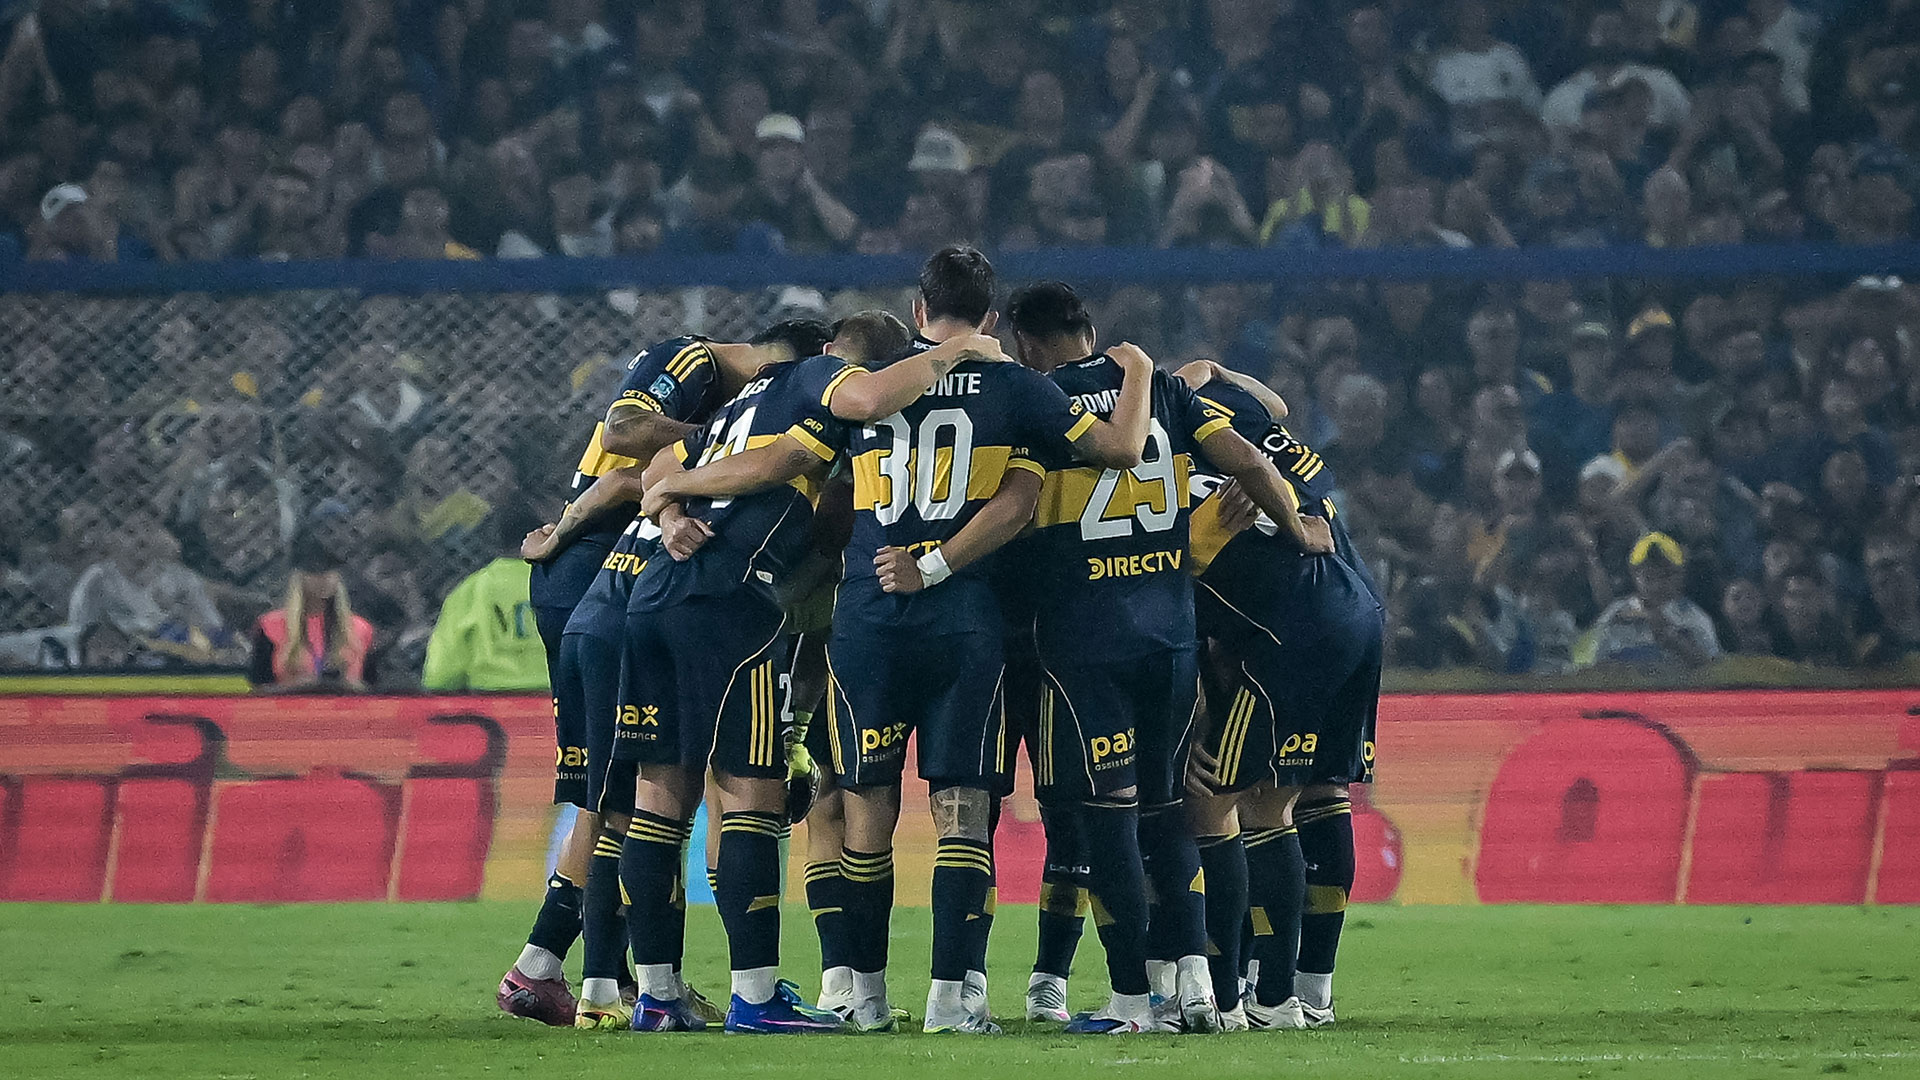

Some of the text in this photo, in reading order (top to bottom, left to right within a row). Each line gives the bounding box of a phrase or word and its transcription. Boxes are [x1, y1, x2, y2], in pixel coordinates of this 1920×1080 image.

[863, 408, 973, 527] 30
[1080, 418, 1178, 541] 29
[1088, 549, 1182, 580] DIRECTV
[862, 722, 907, 755] pax
